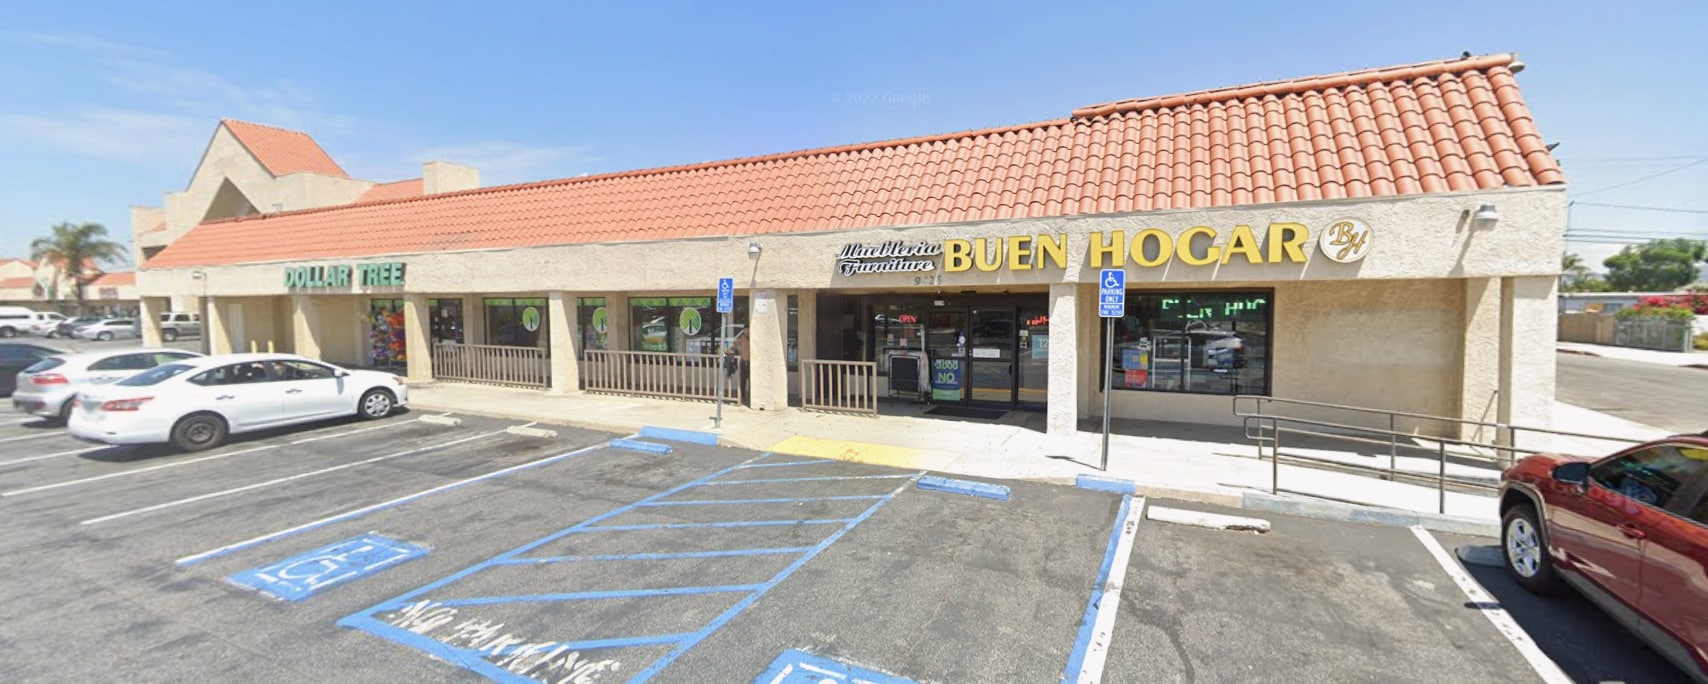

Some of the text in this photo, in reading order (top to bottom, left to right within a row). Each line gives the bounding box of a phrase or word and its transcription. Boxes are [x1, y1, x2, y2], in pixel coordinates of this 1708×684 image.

[943, 221, 1310, 272] BUEN HOGAR
[838, 257, 936, 277] Furniture
[284, 262, 405, 288] DOLLAR TREE
[1101, 288, 1123, 296] PARKING
[1105, 295, 1119, 303] ONLY
[898, 314, 917, 323] OPEN
[937, 372, 956, 382] NO
[388, 600, 458, 633] NO
